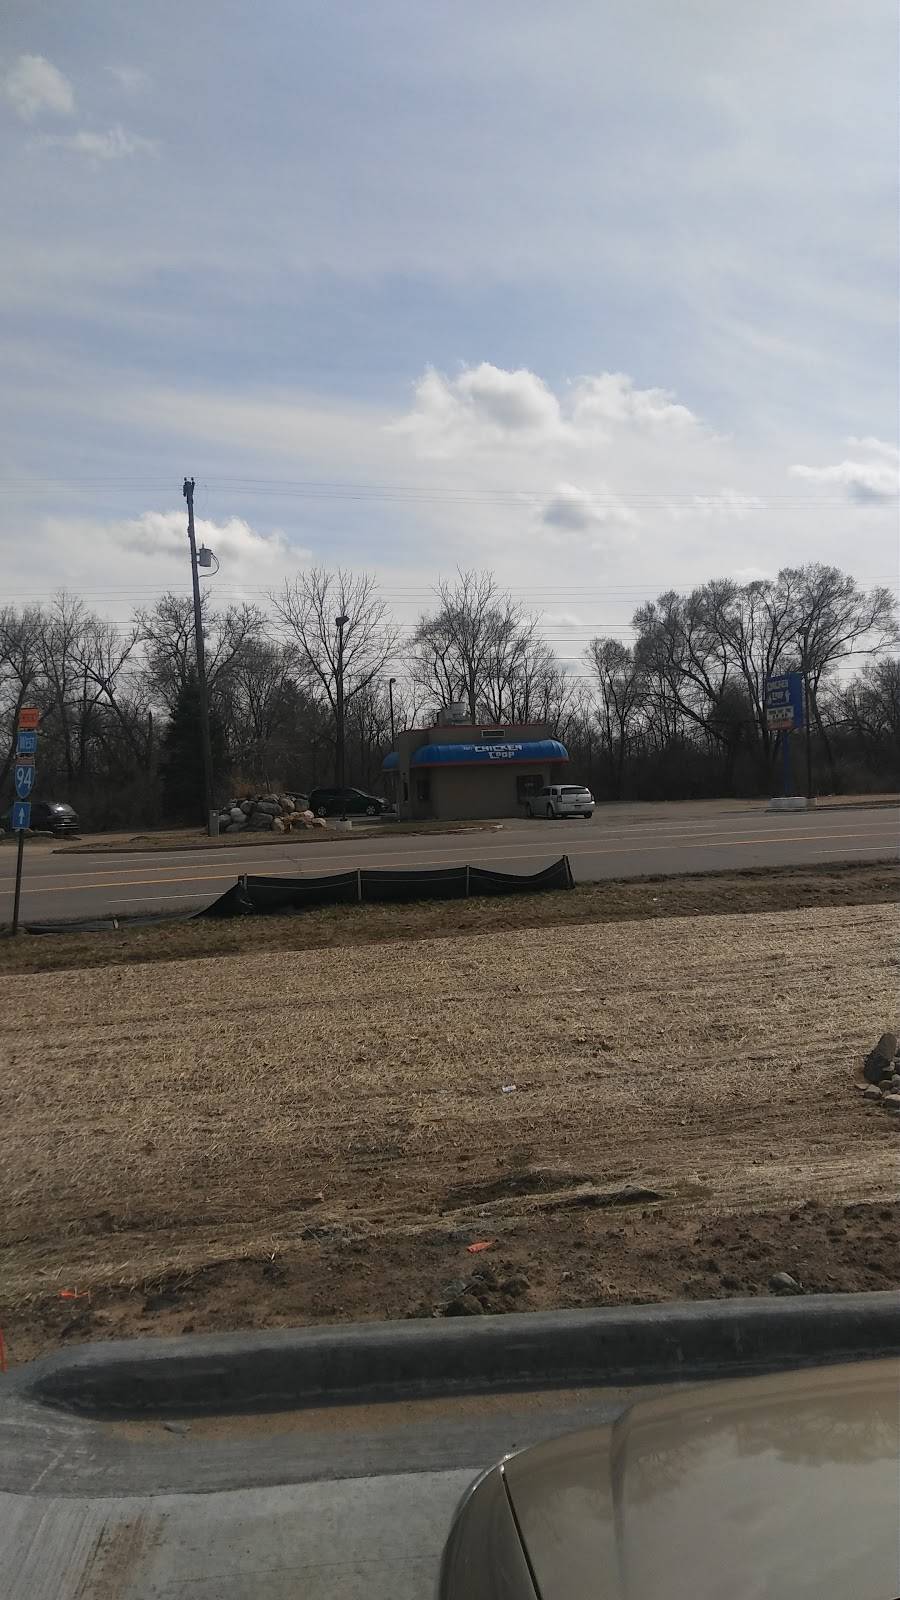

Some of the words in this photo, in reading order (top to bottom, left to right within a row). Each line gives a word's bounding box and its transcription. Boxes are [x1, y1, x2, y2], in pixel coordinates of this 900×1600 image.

[474, 744, 523, 753] CHICKEN
[488, 751, 515, 759] COOP
[16, 767, 32, 789] 94
